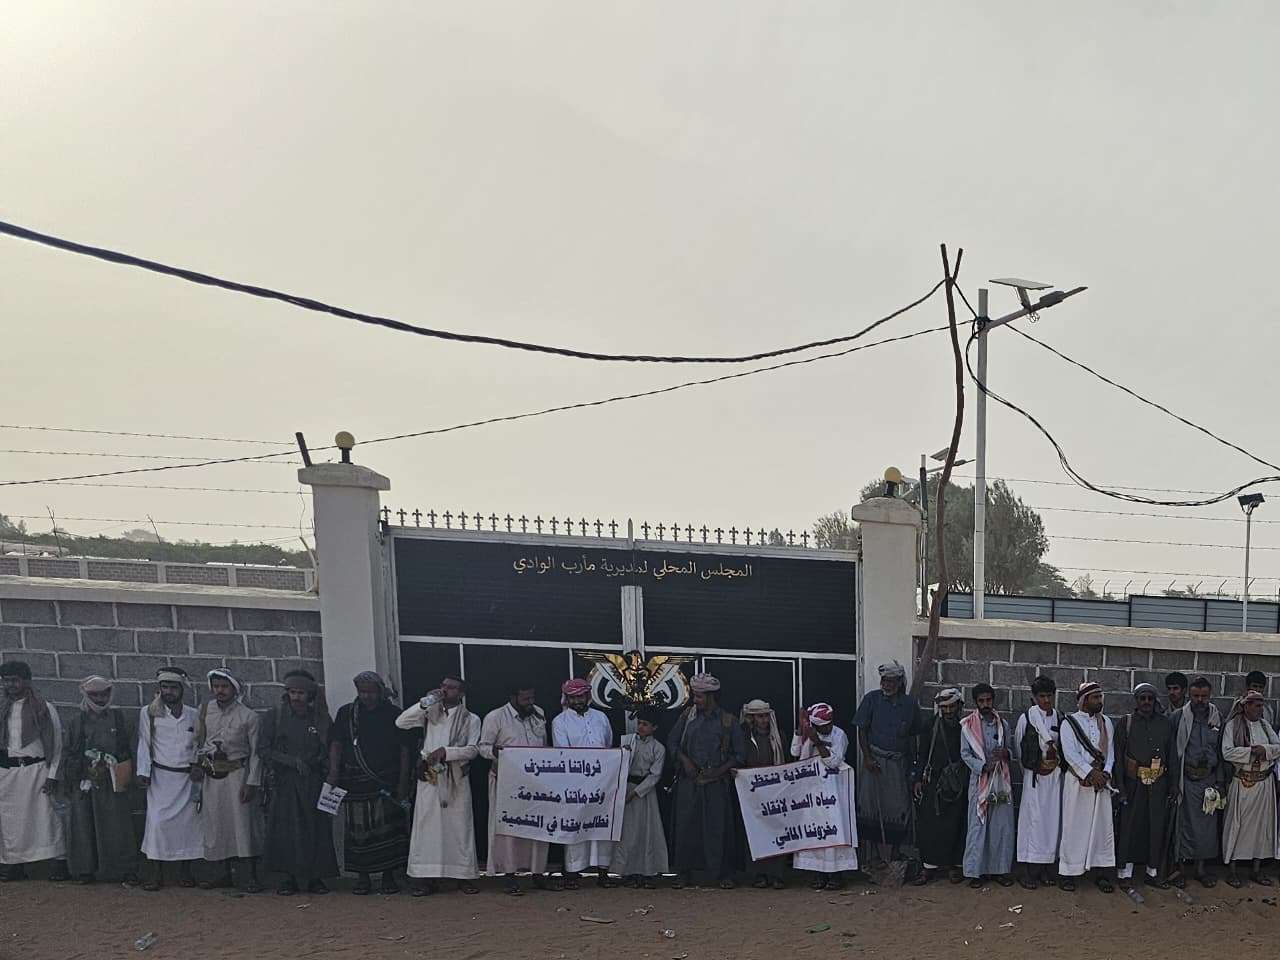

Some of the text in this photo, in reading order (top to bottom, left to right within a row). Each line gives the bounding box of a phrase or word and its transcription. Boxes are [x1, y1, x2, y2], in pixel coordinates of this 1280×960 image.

[512, 555, 555, 574] الوادي
[561, 554, 596, 574] مأرب
[653, 559, 696, 580] المحلي
[701, 562, 752, 580] المجلس
[568, 758, 602, 777] ثرواتنا
[783, 762, 820, 785] التغذية
[750, 772, 781, 792] تنتظر
[760, 792, 837, 817] مياه السد لإنقاذ
[546, 816, 558, 836] في
[560, 817, 580, 835] بحقنا
[582, 814, 609, 833] نطالب
[804, 821, 838, 841] مخزوننا
